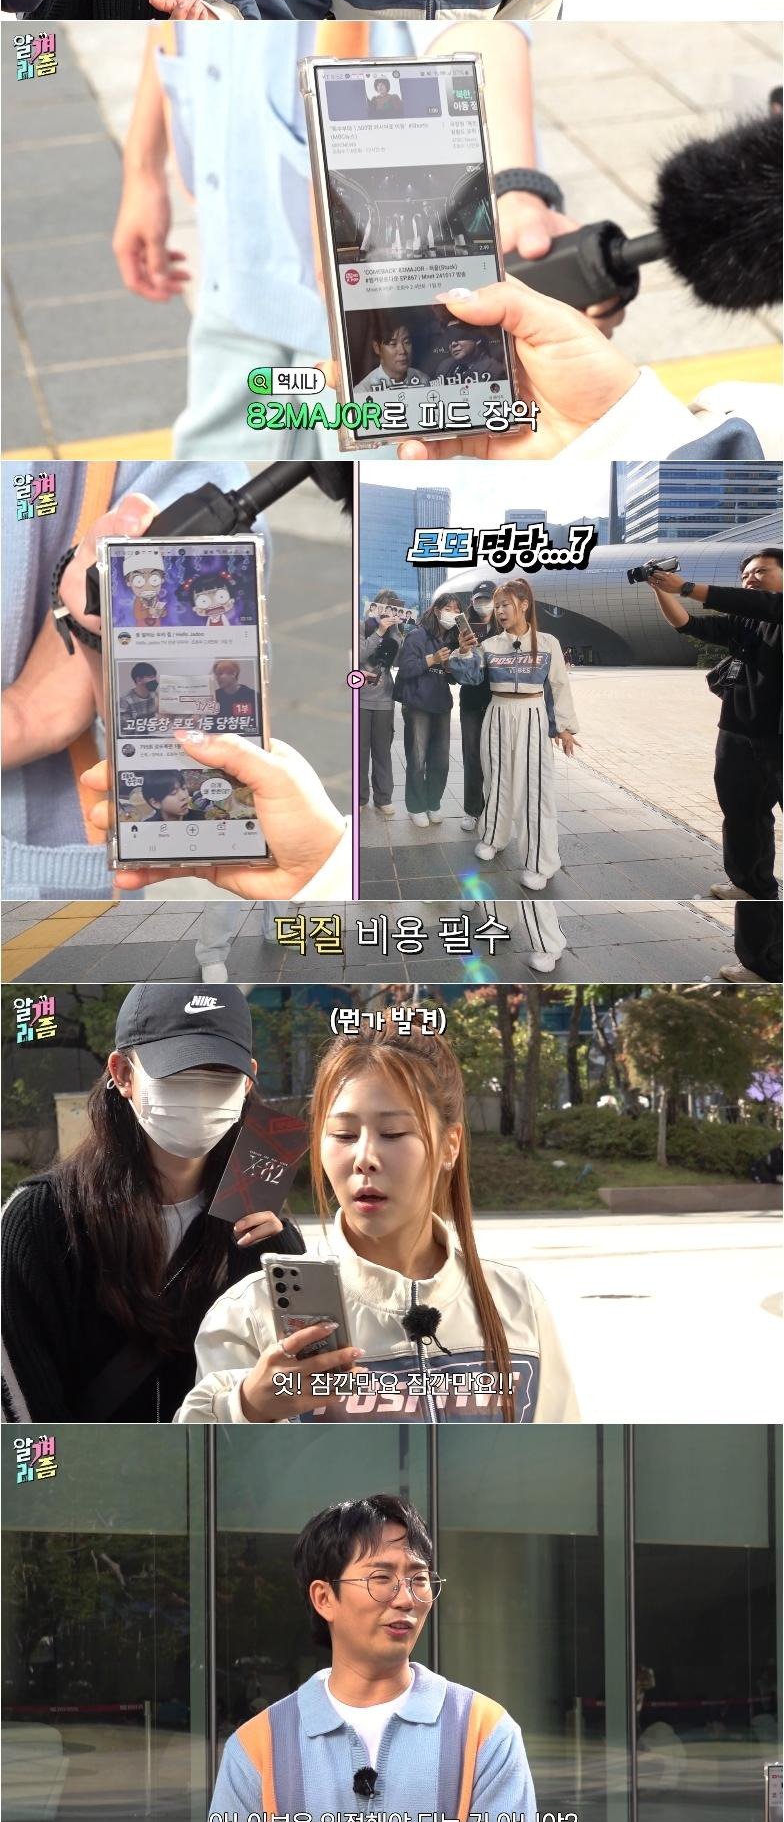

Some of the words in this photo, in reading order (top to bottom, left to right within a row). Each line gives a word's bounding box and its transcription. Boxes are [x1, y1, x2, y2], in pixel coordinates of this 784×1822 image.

[490, 655, 543, 665] POSITIVE
[123, 718, 169, 732] 고딩동창
[172, 718, 194, 731] 로또
[191, 996, 218, 1007] NIKE
